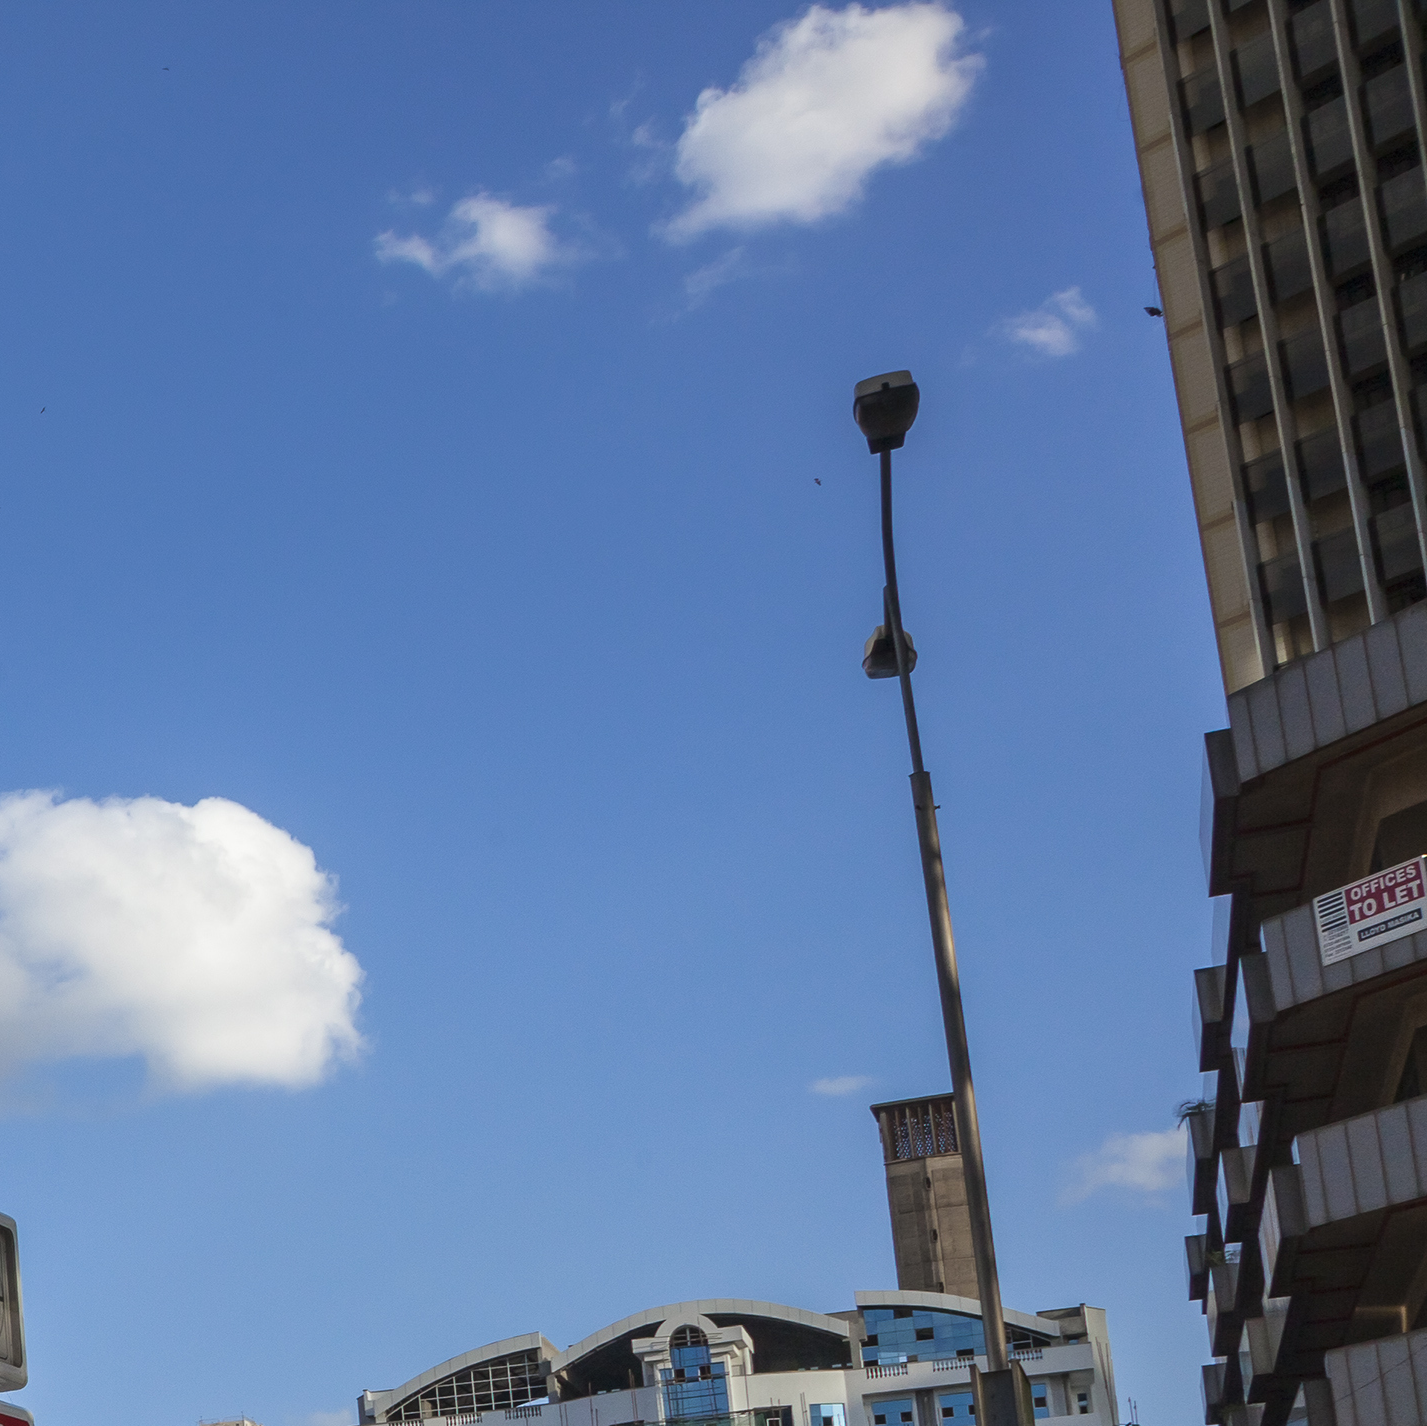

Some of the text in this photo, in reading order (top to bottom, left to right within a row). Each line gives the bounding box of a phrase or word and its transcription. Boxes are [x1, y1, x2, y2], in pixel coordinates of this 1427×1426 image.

[1349, 879, 1421, 920] TO LET
[1350, 865, 1417, 900] OFFICES
[1360, 911, 1420, 939] LLOYD MASIKA
